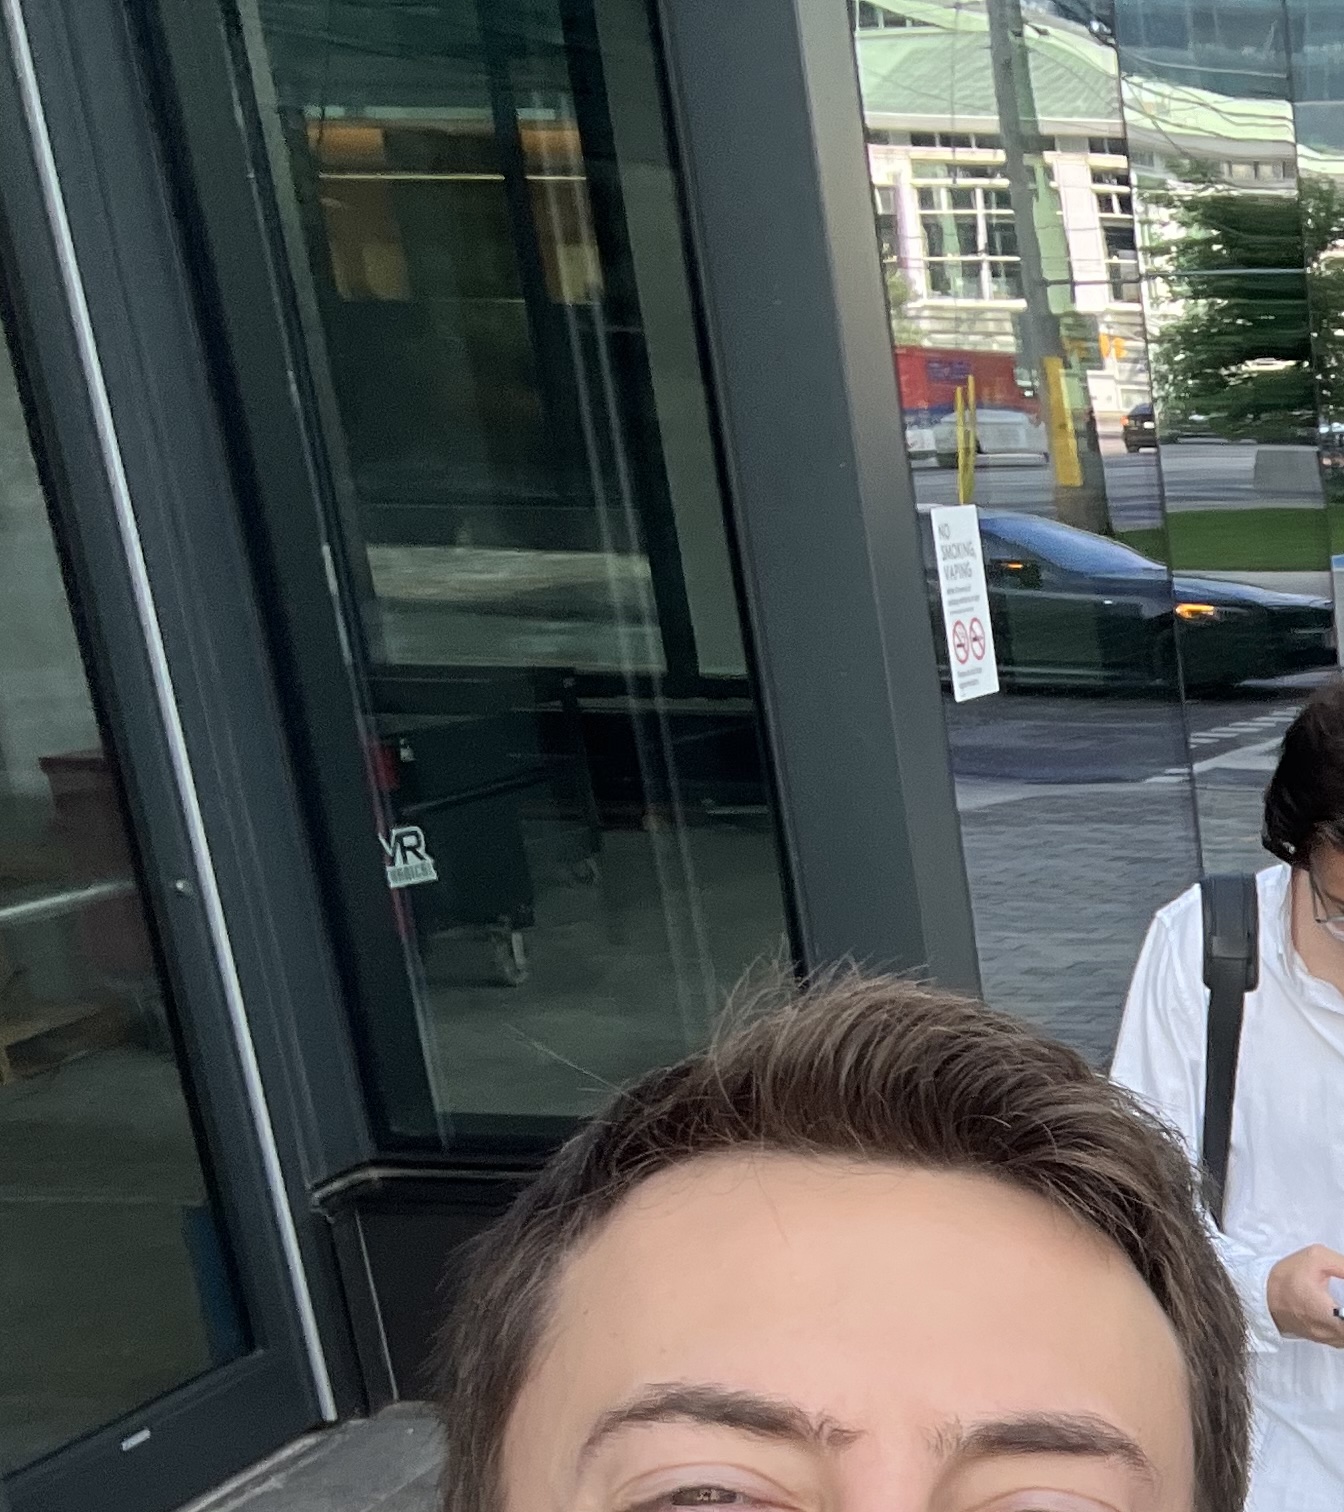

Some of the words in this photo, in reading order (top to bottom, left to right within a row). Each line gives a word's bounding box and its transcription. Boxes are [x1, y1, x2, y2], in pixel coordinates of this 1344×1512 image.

[938, 523, 951, 540] NO
[941, 541, 977, 561] SMOKING
[944, 561, 973, 581] VAPING
